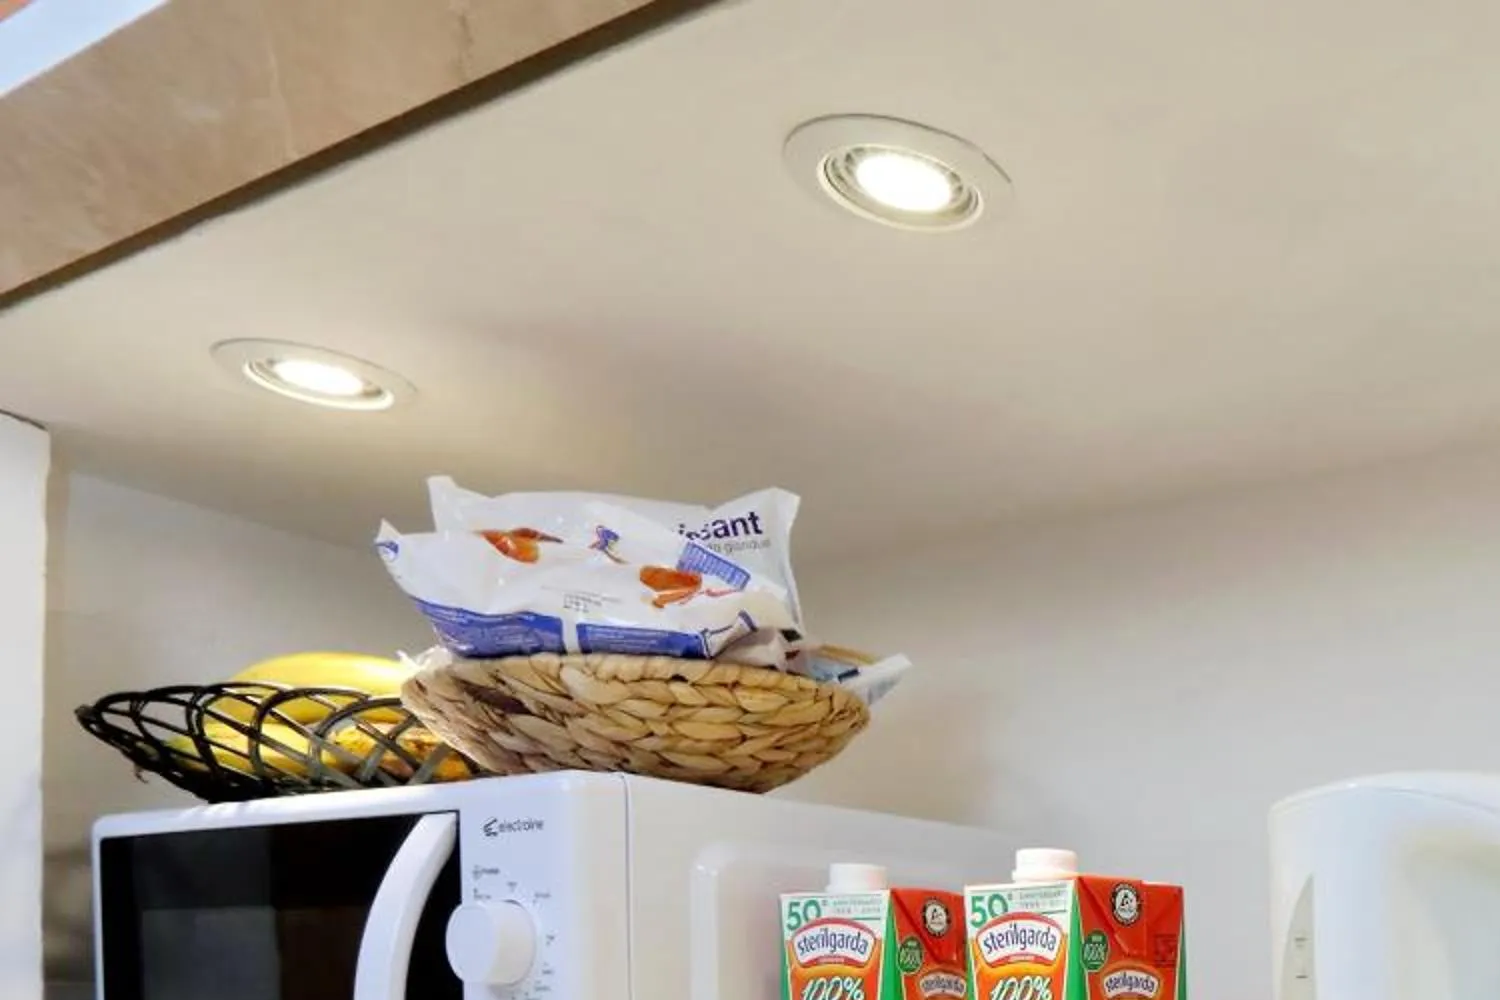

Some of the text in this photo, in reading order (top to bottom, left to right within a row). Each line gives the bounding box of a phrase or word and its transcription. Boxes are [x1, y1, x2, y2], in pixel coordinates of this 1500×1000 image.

[797, 928, 869, 955] sterilgarda
[983, 923, 1056, 954] sterilgarda
[1106, 972, 1155, 993] sterilgarda
